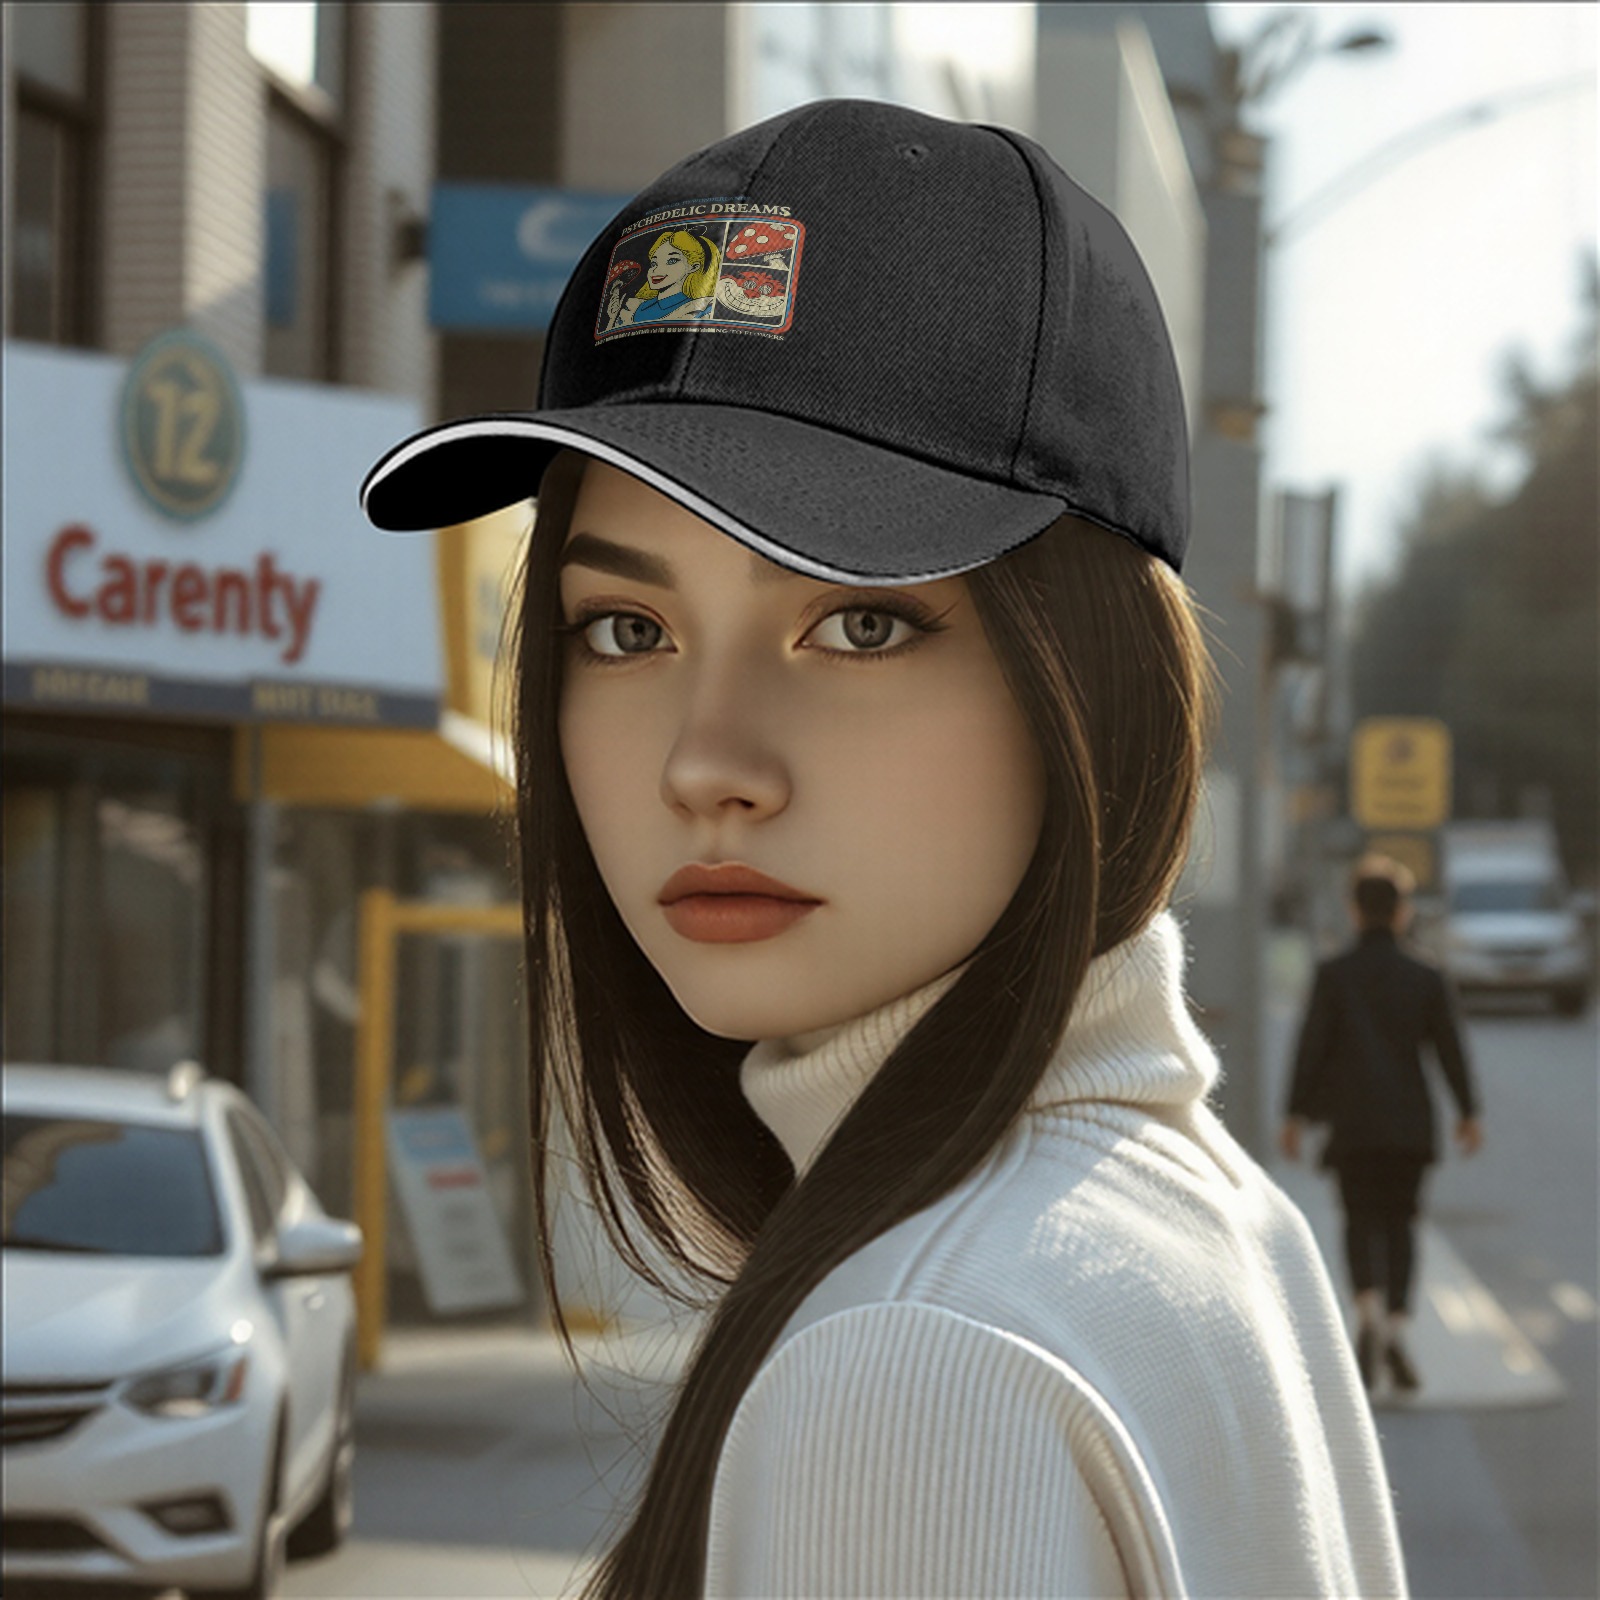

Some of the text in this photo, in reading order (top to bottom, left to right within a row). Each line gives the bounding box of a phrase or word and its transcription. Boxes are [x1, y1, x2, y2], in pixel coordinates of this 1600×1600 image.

[621, 203, 791, 237] PSYCHEDELIC DREAMS
[46, 523, 320, 665] Carenty
